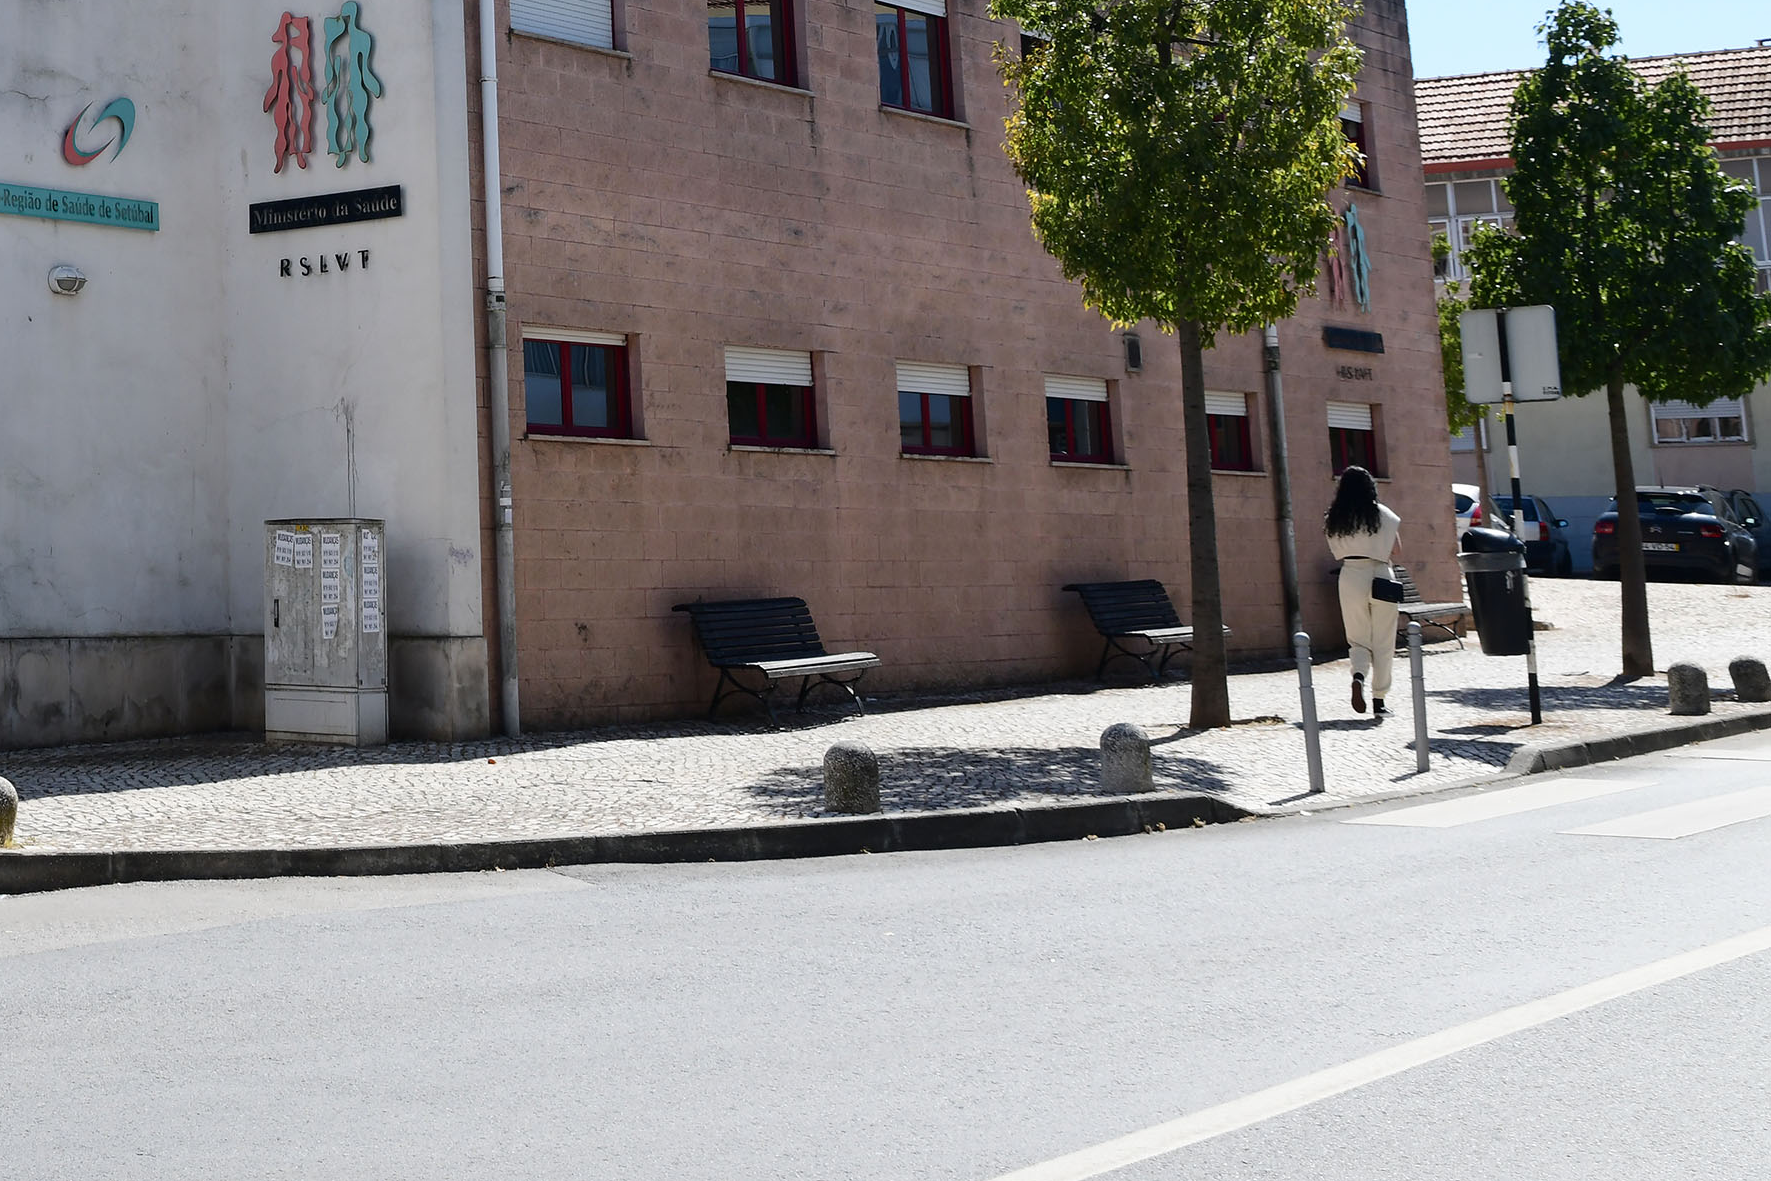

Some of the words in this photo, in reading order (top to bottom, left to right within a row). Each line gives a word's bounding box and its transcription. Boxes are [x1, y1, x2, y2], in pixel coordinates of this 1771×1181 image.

[45, 192, 59, 212] de
[62, 195, 95, 217] Saúde
[99, 199, 112, 219] de
[115, 202, 154, 224] Setúbal
[332, 200, 349, 217] da
[356, 194, 398, 214] Saúde
